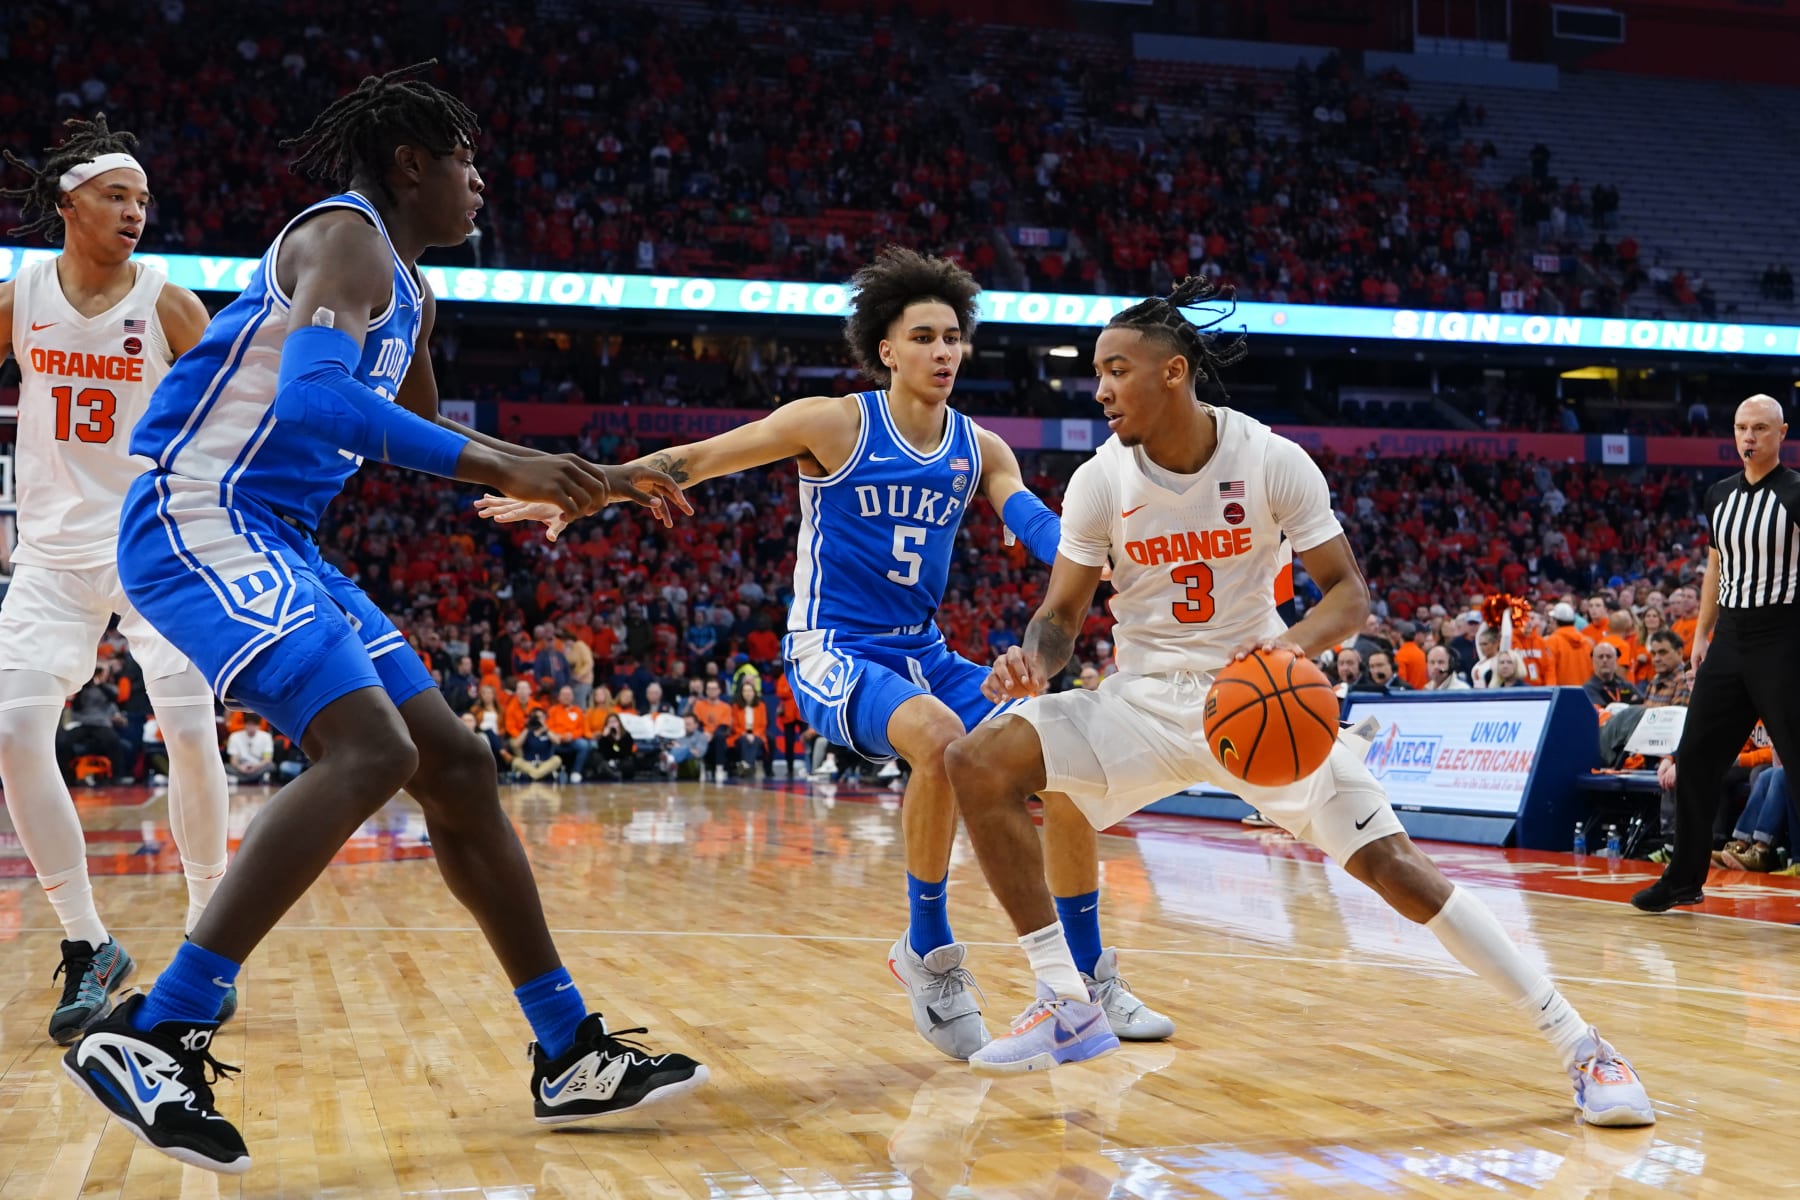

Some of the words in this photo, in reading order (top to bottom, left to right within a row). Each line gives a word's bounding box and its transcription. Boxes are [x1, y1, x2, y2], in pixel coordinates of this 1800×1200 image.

[427, 268, 625, 306] ASSION
[650, 277, 716, 310] TO
[740, 281, 848, 315] CRO
[989, 292, 1145, 326] TODA
[1392, 310, 1582, 345] SIGN-ON
[1600, 319, 1745, 352] BONUS
[30, 348, 144, 382] ORANGE
[51, 385, 117, 444] 13
[855, 485, 958, 527] DUKE
[886, 524, 927, 586] 5
[1124, 527, 1253, 566] ORANGE
[1170, 561, 1216, 624] 3
[1470, 721, 1522, 743] UNION
